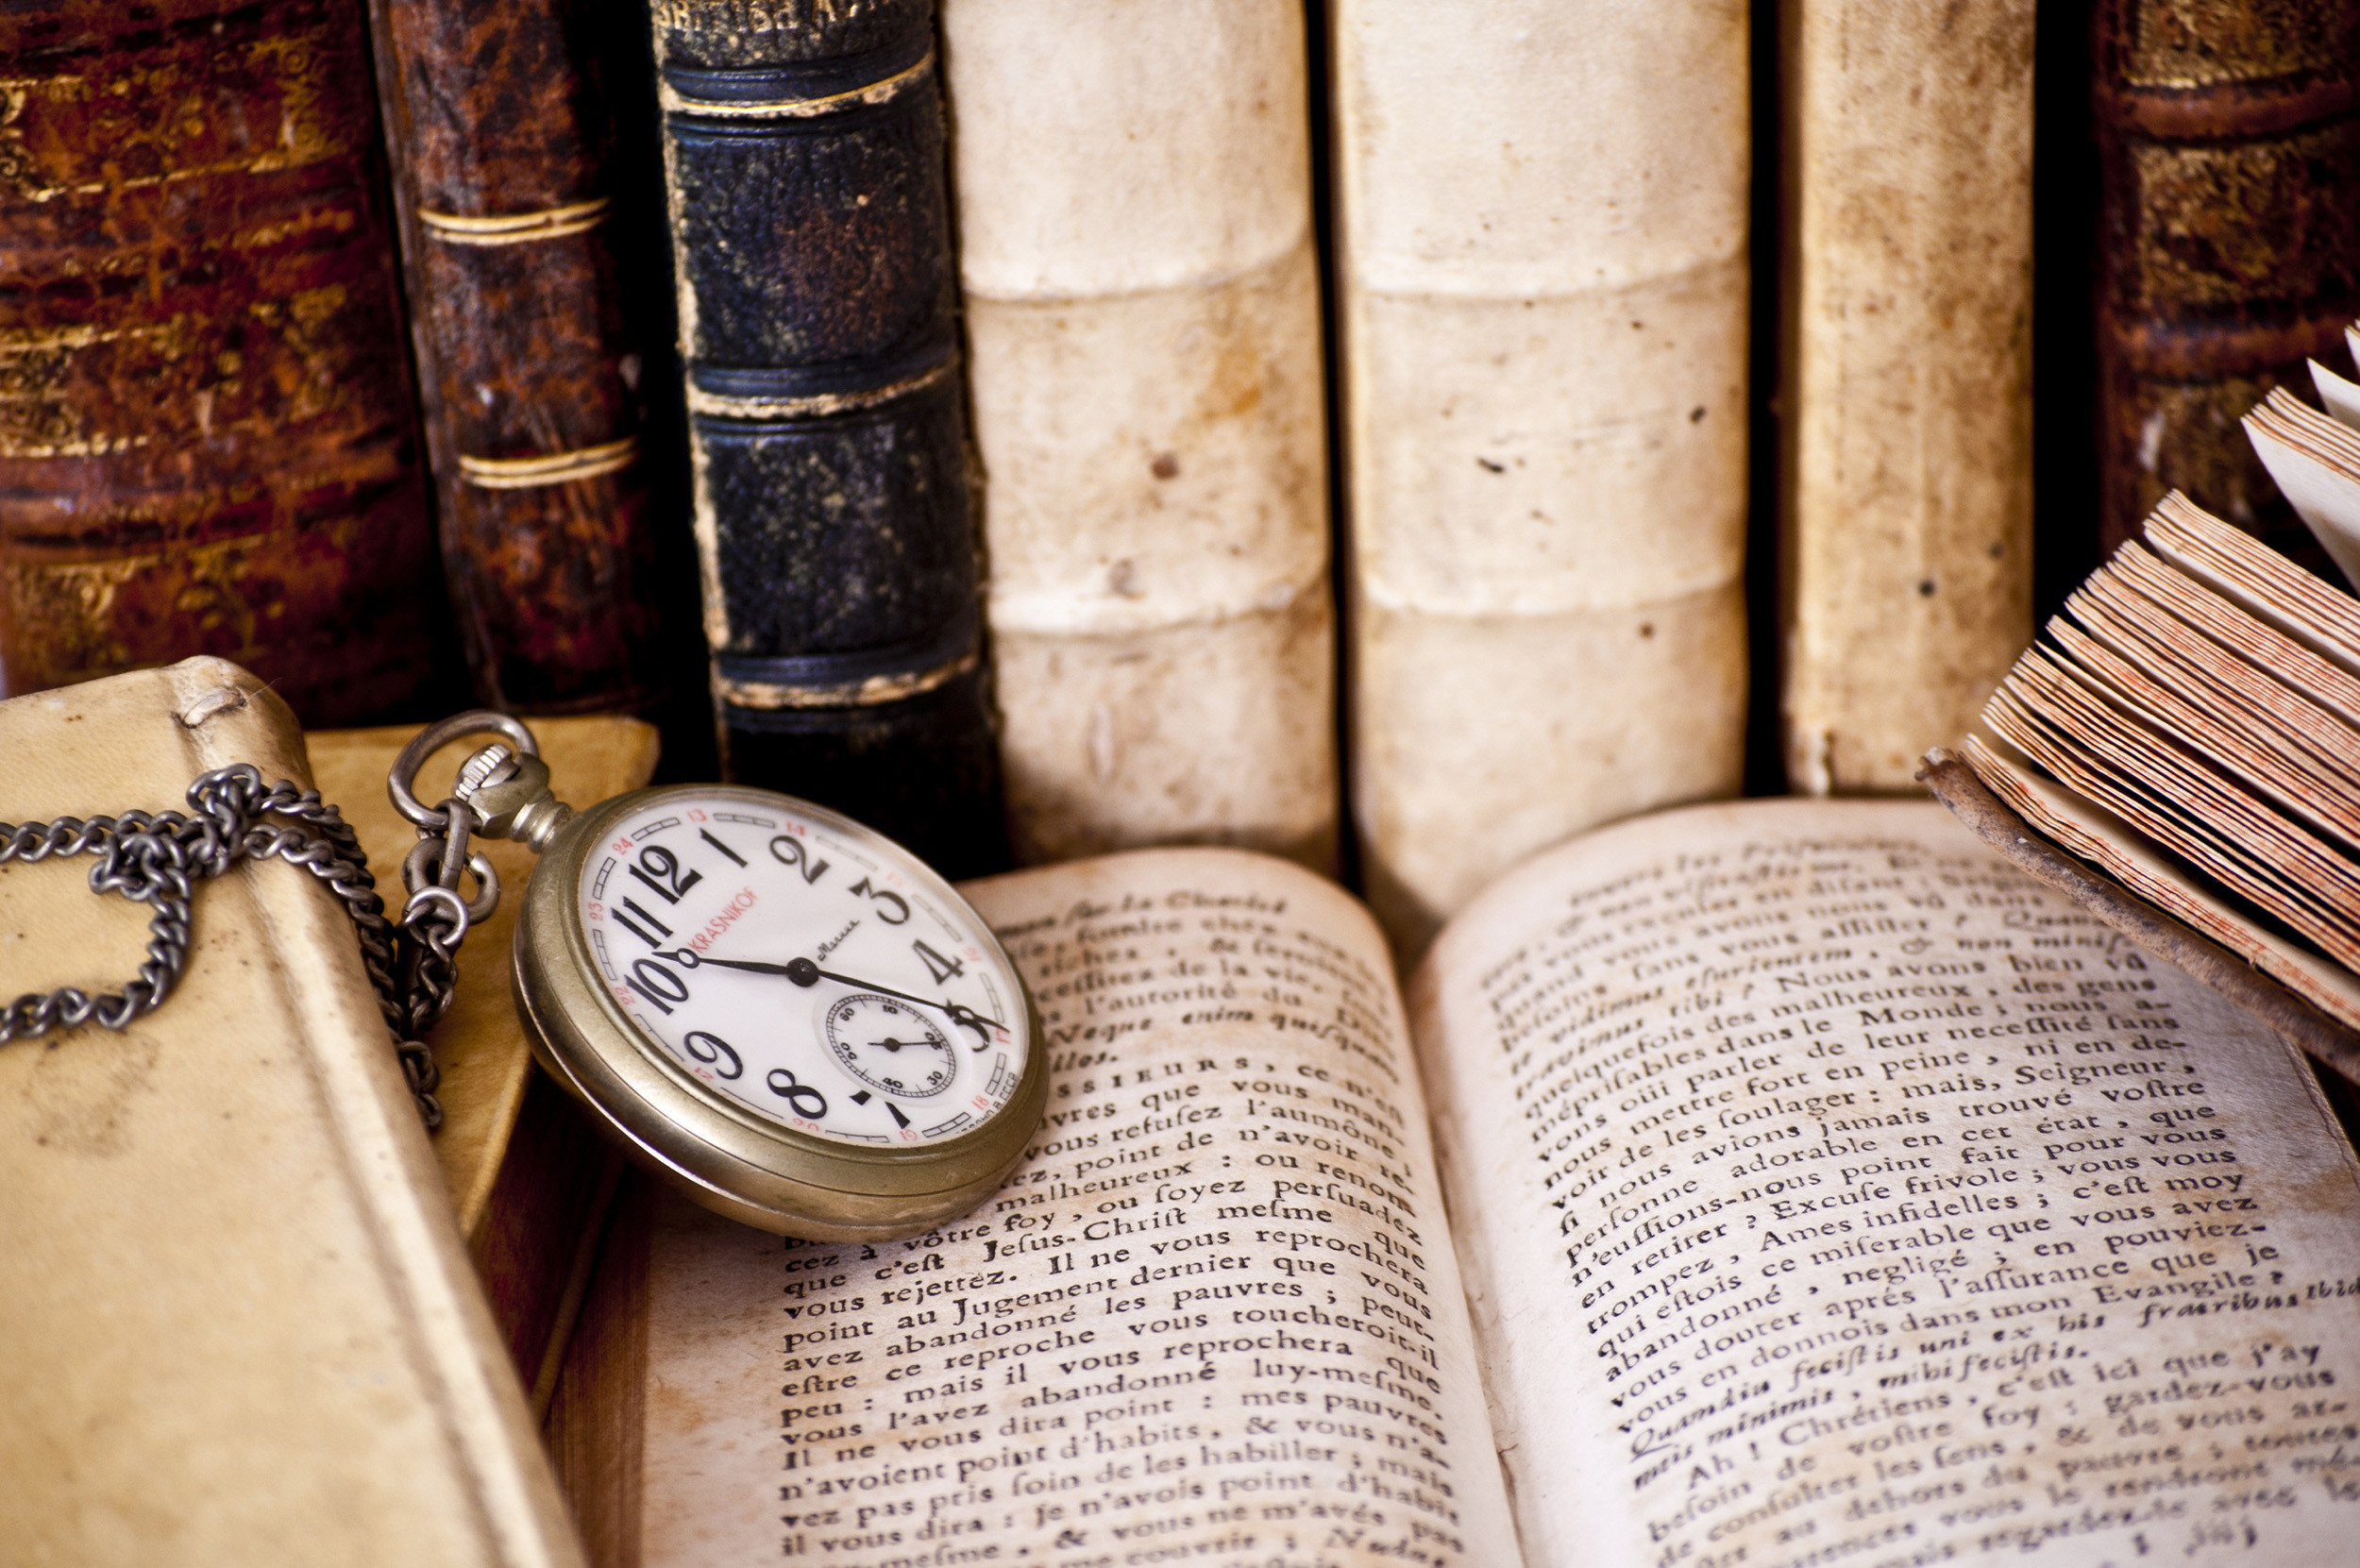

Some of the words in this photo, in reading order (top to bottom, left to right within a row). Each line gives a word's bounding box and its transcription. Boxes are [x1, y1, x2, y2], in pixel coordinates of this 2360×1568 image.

[686, 807, 708, 824] 13
[786, 820, 806, 837] 14
[612, 836, 633, 856] 24
[700, 827, 748, 868] 1
[769, 835, 831, 885] 2
[629, 845, 703, 905] 12
[848, 876, 910, 926] 3
[588, 902, 604, 921] 23
[611, 895, 673, 950] 11
[623, 958, 689, 1016] 10
[912, 938, 964, 986] 4
[614, 986, 636, 1005] 22
[839, 1007, 855, 1021] 60
[882, 1004, 899, 1015] 10
[1705, 1012, 1756, 1034] des
[1770, 985, 1969, 1019] malheureux
[2013, 977, 2065, 996] des
[840, 1042, 858, 1061] 50
[946, 998, 990, 1053] 5
[1716, 1026, 1793, 1054] dans
[1801, 1019, 1832, 1036] le
[1859, 1003, 1982, 1026] Monde
[2026, 998, 2107, 1013] nous
[683, 1031, 743, 1080] 9
[883, 1077, 903, 1089] 40
[926, 1071, 943, 1086] 30
[767, 1068, 828, 1120] 8
[971, 1094, 988, 1111] 18
[1141, 1084, 1201, 1112] que
[1232, 1078, 1308, 1100] vous
[1538, 1115, 1608, 1163] vons
[1686, 1053, 1781, 1094] parler
[1807, 1041, 1845, 1060] de
[1868, 1029, 1930, 1049] leur
[1542, 1137, 1611, 1190] nous
[1630, 1089, 1733, 1136] mettre
[1746, 1071, 1811, 1096] fort
[1825, 1064, 1864, 1081] en
[1881, 1051, 1971, 1080] peine
[2025, 1039, 2060, 1056] ni
[2075, 1037, 2116, 1054] en
[900, 1129, 918, 1142] 19
[1025, 1129, 1099, 1161] vous
[1074, 1144, 1161, 1179] point
[1176, 1131, 1214, 1154] de
[1239, 1125, 1357, 1162] n'avoir
[1551, 1166, 1609, 1210] voir
[1619, 1143, 1654, 1170] de
[1665, 1122, 1707, 1147] les
[1902, 1073, 2001, 1099] mais,
[1599, 1162, 1672, 1208] nous
[1692, 1124, 1801, 1165] avions
[1818, 1106, 1930, 1138] jamais
[1958, 1087, 2073, 1118] trouvé
[1729, 1137, 1879, 1179] adorable
[1901, 1133, 1944, 1149] en
[1961, 1123, 2013, 1142] cet
[2035, 1112, 2101, 1135] état
[2149, 1105, 2217, 1128] que
[1840, 1156, 1932, 1186] point
[1961, 1143, 2021, 1165] fait
[2043, 1135, 2125, 1160] pour
[2139, 1127, 2228, 1146] vous
[997, 1161, 1192, 1212] malheureux
[1255, 1153, 1299, 1170] ou
[1097, 1196, 1138, 1215] ou
[1580, 1277, 1615, 1309] en
[1630, 1222, 1728, 1275] retirer
[1905, 1167, 2019, 1197] frivole
[2056, 1156, 2140, 1176] vous
[2150, 1148, 2237, 1168] vous
[1760, 1218, 1852, 1253] Ames
[1863, 1190, 2019, 1229] infidelles
[2166, 1173, 2244, 1193] moy
[784, 1274, 847, 1300] que
[1048, 1252, 1073, 1274] Il
[1090, 1248, 1131, 1268] ne
[1150, 1231, 1231, 1256] vous
[1256, 1230, 1427, 1295] reprochera
[903, 1224, 991, 1252] vôtre
[1374, 1231, 1425, 1270] que
[783, 1322, 873, 1354] point
[898, 1310, 937, 1329] au
[952, 1274, 1118, 1325] Jugement
[1130, 1255, 1252, 1286] dernier
[1273, 1256, 1336, 1276] que
[1360, 1272, 1432, 1321] vous
[1596, 1313, 1647, 1360] qui
[1761, 1258, 1797, 1277] ce
[1987, 1218, 2052, 1243] que
[2070, 1205, 2156, 1228] vous
[2171, 1196, 2259, 1216] avez
[784, 1296, 865, 1320] vous
[784, 1350, 864, 1372] avez
[885, 1306, 1077, 1357] abandonné
[1105, 1296, 1146, 1315] les
[1172, 1282, 1303, 1310] pauvres
[1606, 1284, 1782, 1382] abandonné
[1843, 1249, 1969, 1286] negligé
[2033, 1239, 2076, 1256] en
[1610, 1359, 1682, 1408] vous
[1694, 1312, 1803, 1361] douter
[1826, 1286, 1917, 1320] aprés
[2150, 1250, 2217, 1276] que
[2245, 1243, 2280, 1267] je
[885, 1363, 921, 1381] ce
[944, 1328, 1095, 1372] reproche
[1128, 1312, 1208, 1337] vous
[1618, 1387, 1688, 1434] vous
[1700, 1362, 1740, 1388] en
[1751, 1318, 1888, 1368] donnois
[1899, 1308, 1981, 1332] dans
[1991, 1295, 2072, 1320] mon
[2092, 1271, 2256, 1305] Evangile
[781, 1404, 843, 1428] peu
[903, 1377, 984, 1405] mais
[1004, 1365, 1026, 1385] il
[1058, 1350, 1140, 1375] vous
[1163, 1330, 1353, 1361] reprochera
[1385, 1357, 1441, 1394] que
[781, 1424, 864, 1447] vous
[887, 1404, 989, 1430] l'avez
[1020, 1362, 1216, 1408] abandonné
[784, 1449, 810, 1471] Il
[835, 1443, 875, 1463] ne
[899, 1427, 982, 1453] vous
[999, 1415, 1067, 1437] dira
[1085, 1398, 1173, 1430] point
[1241, 1390, 1308, 1408] mes
[1323, 1391, 1447, 1445] pauvres
[1200, 1440, 1336, 1465] habiller
[778, 1461, 945, 1501] n'avoient
[957, 1444, 1047, 1484] point
